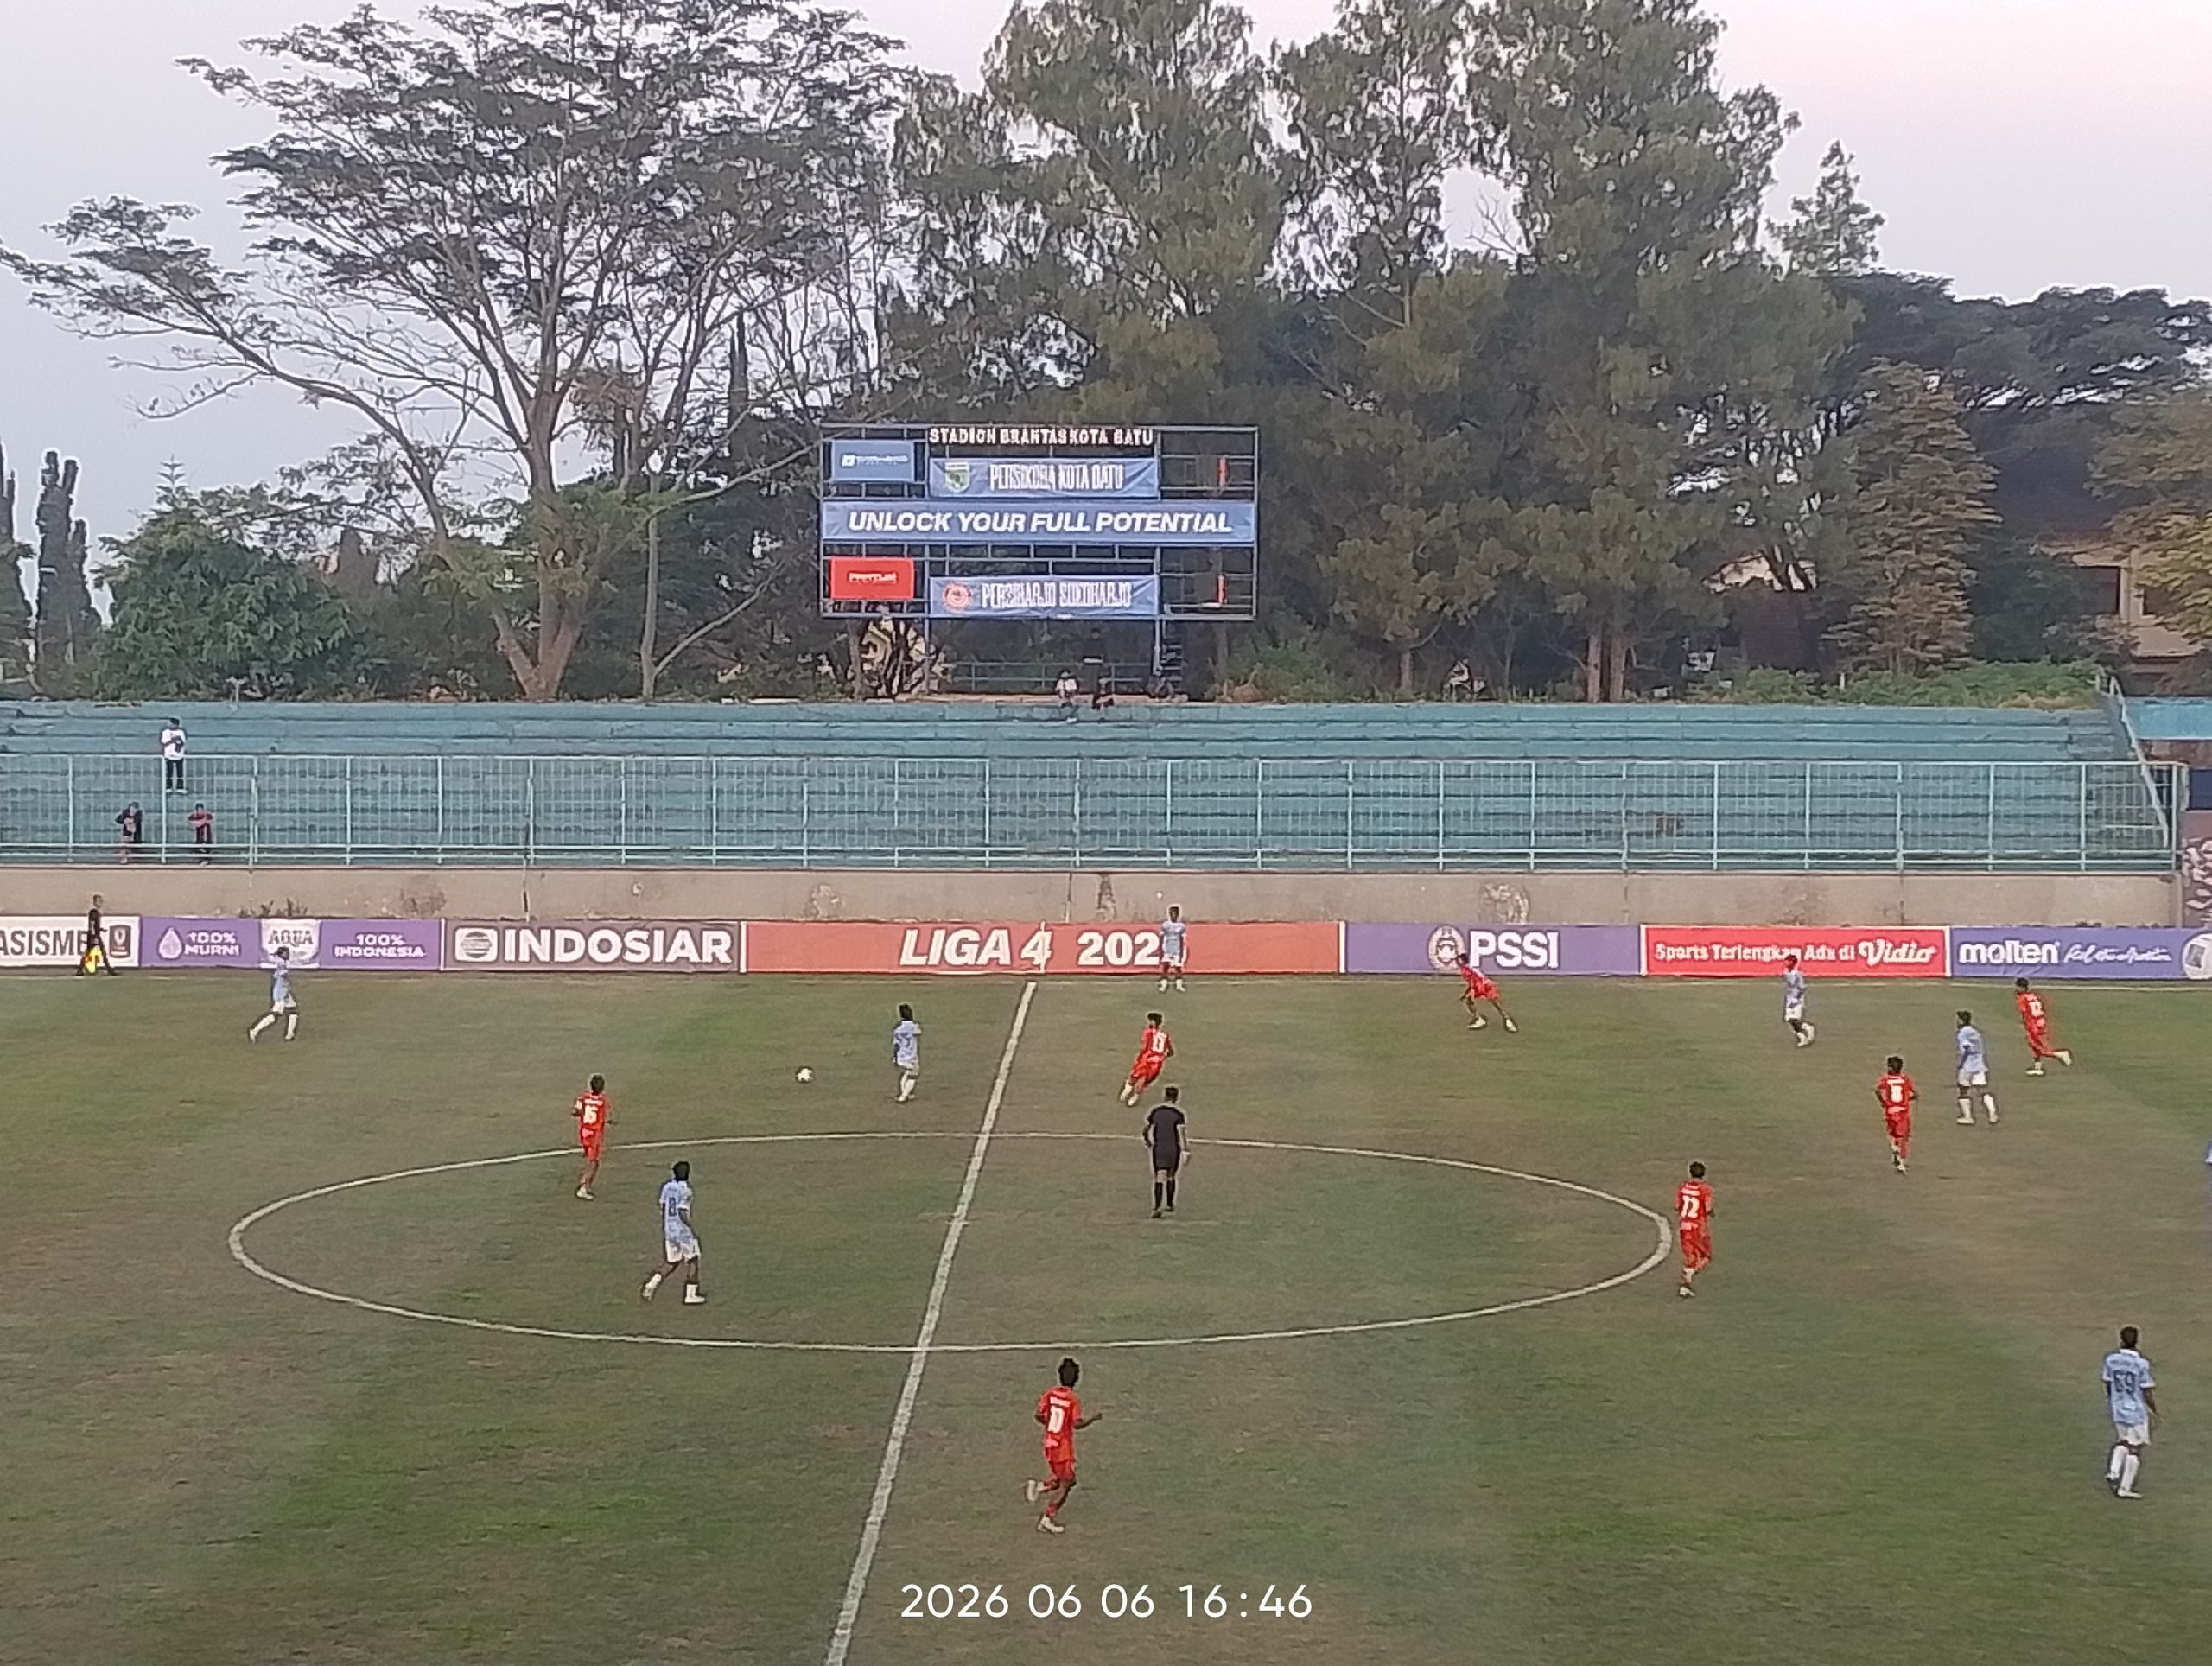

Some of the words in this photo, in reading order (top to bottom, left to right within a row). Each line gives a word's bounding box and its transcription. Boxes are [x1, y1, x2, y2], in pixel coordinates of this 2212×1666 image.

[929, 427, 994, 444] STADION
[1000, 428, 1066, 445] BRANTAS
[1069, 429, 1109, 445] KOTA
[1113, 429, 1154, 446] BATU
[849, 512, 952, 531] UNLOCK
[958, 512, 1026, 532] YOUR
[1031, 512, 1090, 532] FULL
[1096, 512, 1232, 532] POTENTIAL
[188, 932, 237, 944] 100%
[268, 930, 314, 948] AQUA
[355, 933, 406, 946] 100%
[505, 928, 732, 963] INDOSIAR
[899, 929, 1011, 965] LIGA
[1020, 929, 1052, 965] 4
[184, 944, 240, 957] MURNI
[334, 946, 426, 958] INDONESIA
[1470, 931, 1559, 968] PSSI
[1656, 943, 1709, 961] Sports
[1803, 944, 1836, 961] Ada
[1839, 944, 1855, 961] di
[1858, 938, 1938, 967] Vidio
[1958, 940, 2059, 964] molten
